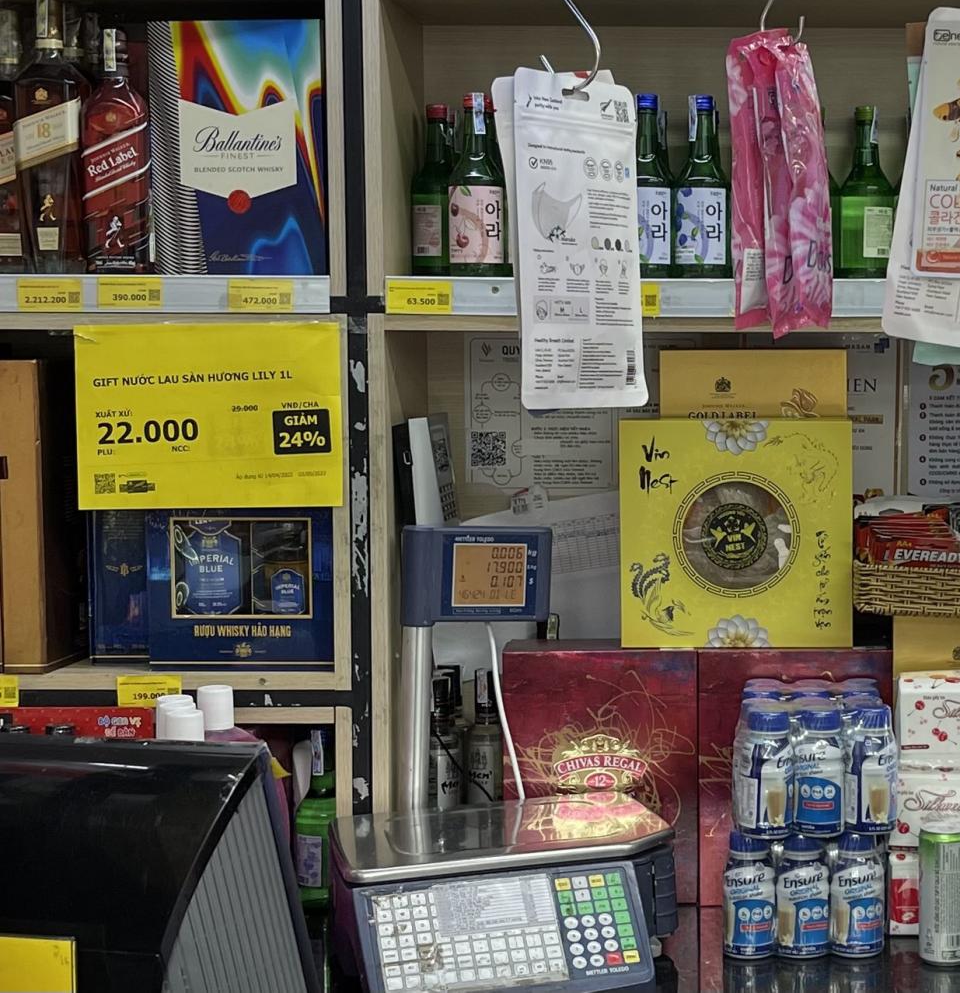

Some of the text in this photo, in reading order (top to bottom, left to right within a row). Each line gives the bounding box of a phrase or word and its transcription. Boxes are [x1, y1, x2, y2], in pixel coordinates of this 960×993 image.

[36, 121, 51, 139] 18
[193, 125, 283, 152] Ballantine's
[87, 145, 139, 178] Red Label
[220, 152, 256, 160] FINEST
[194, 166, 285, 174] BLENDED SCOTCH WHISKY
[24, 295, 67, 305] 2.212.200
[112, 293, 148, 302] 390.000
[242, 296, 278, 305] 472.000
[93, 369, 293, 388] GIFT NƯỚC LAU SÀN HƯƠNG LILY 1L
[283, 413, 318, 427] GIẢM
[97, 418, 199, 445] 22.000
[278, 430, 326, 449] 24%
[641, 436, 670, 463] Vin
[199, 564, 223, 573] BLUE
[217, 624, 250, 637] WHISKY
[251, 622, 268, 637] HẢO
[269, 623, 292, 639] HẠNG
[557, 756, 643, 774] CHIVAS REGAL
[595, 775, 607, 787] 12
[725, 872, 766, 888] Ensure
[783, 872, 824, 889] Ensure
[838, 872, 878, 888] Ensure
